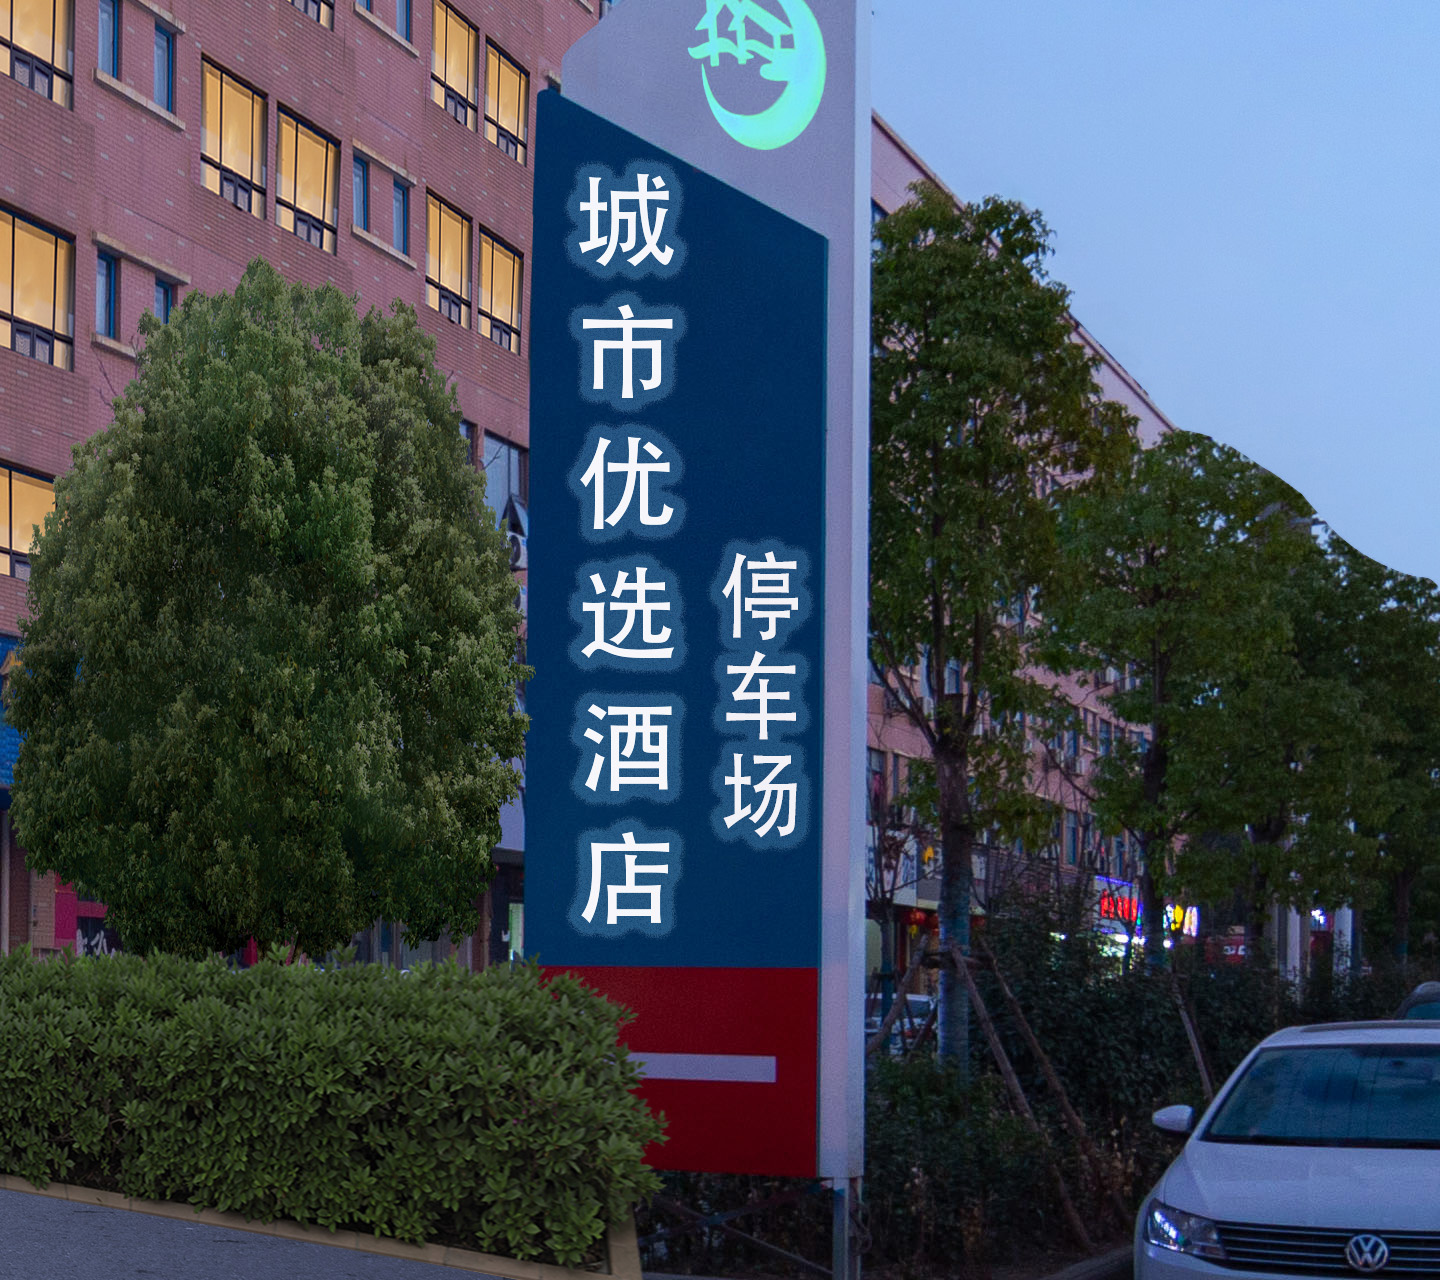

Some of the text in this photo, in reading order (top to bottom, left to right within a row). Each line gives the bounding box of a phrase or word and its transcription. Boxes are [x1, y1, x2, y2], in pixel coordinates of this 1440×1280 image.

[578, 172, 676, 927] 城市优选酒店
[722, 550, 800, 839] 停车场
